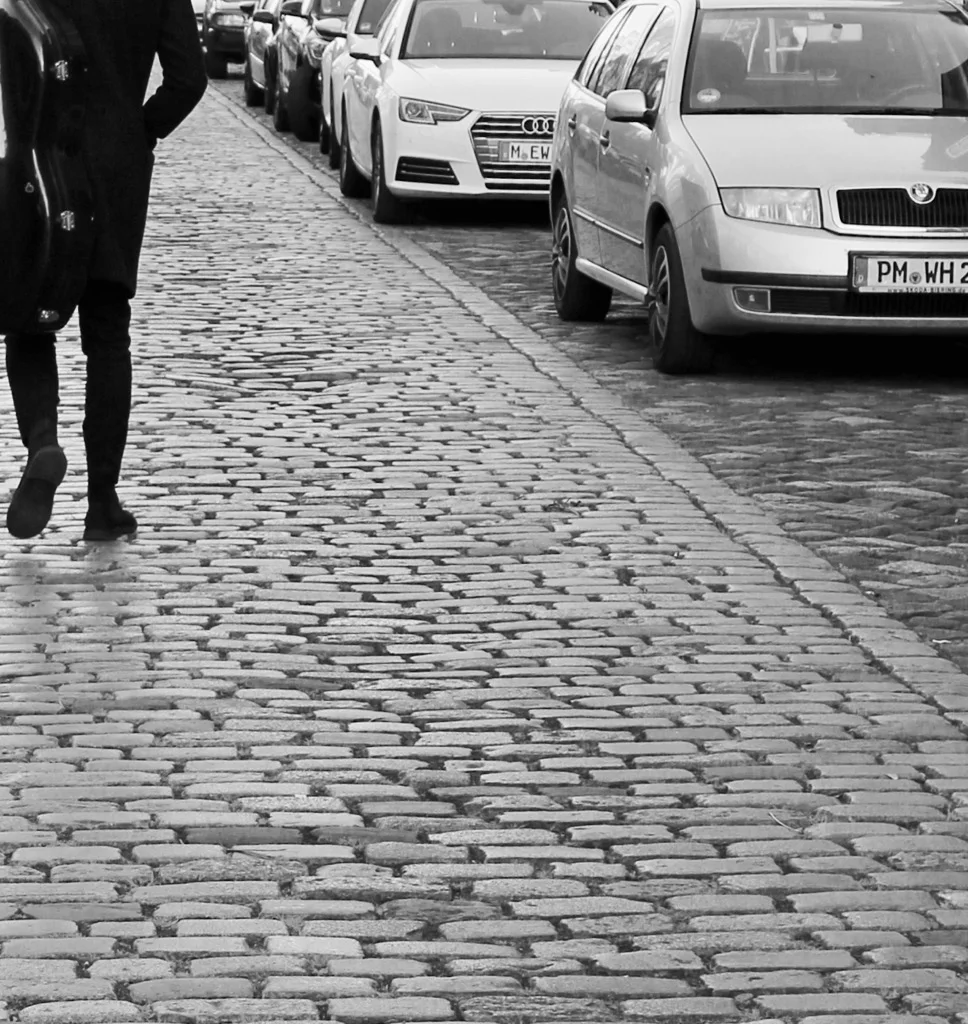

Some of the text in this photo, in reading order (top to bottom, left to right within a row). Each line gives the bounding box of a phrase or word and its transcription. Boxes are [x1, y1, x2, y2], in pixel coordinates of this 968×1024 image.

[511, 145, 550, 160] M EW
[877, 261, 908, 284] PM
[924, 261, 954, 284] WH
